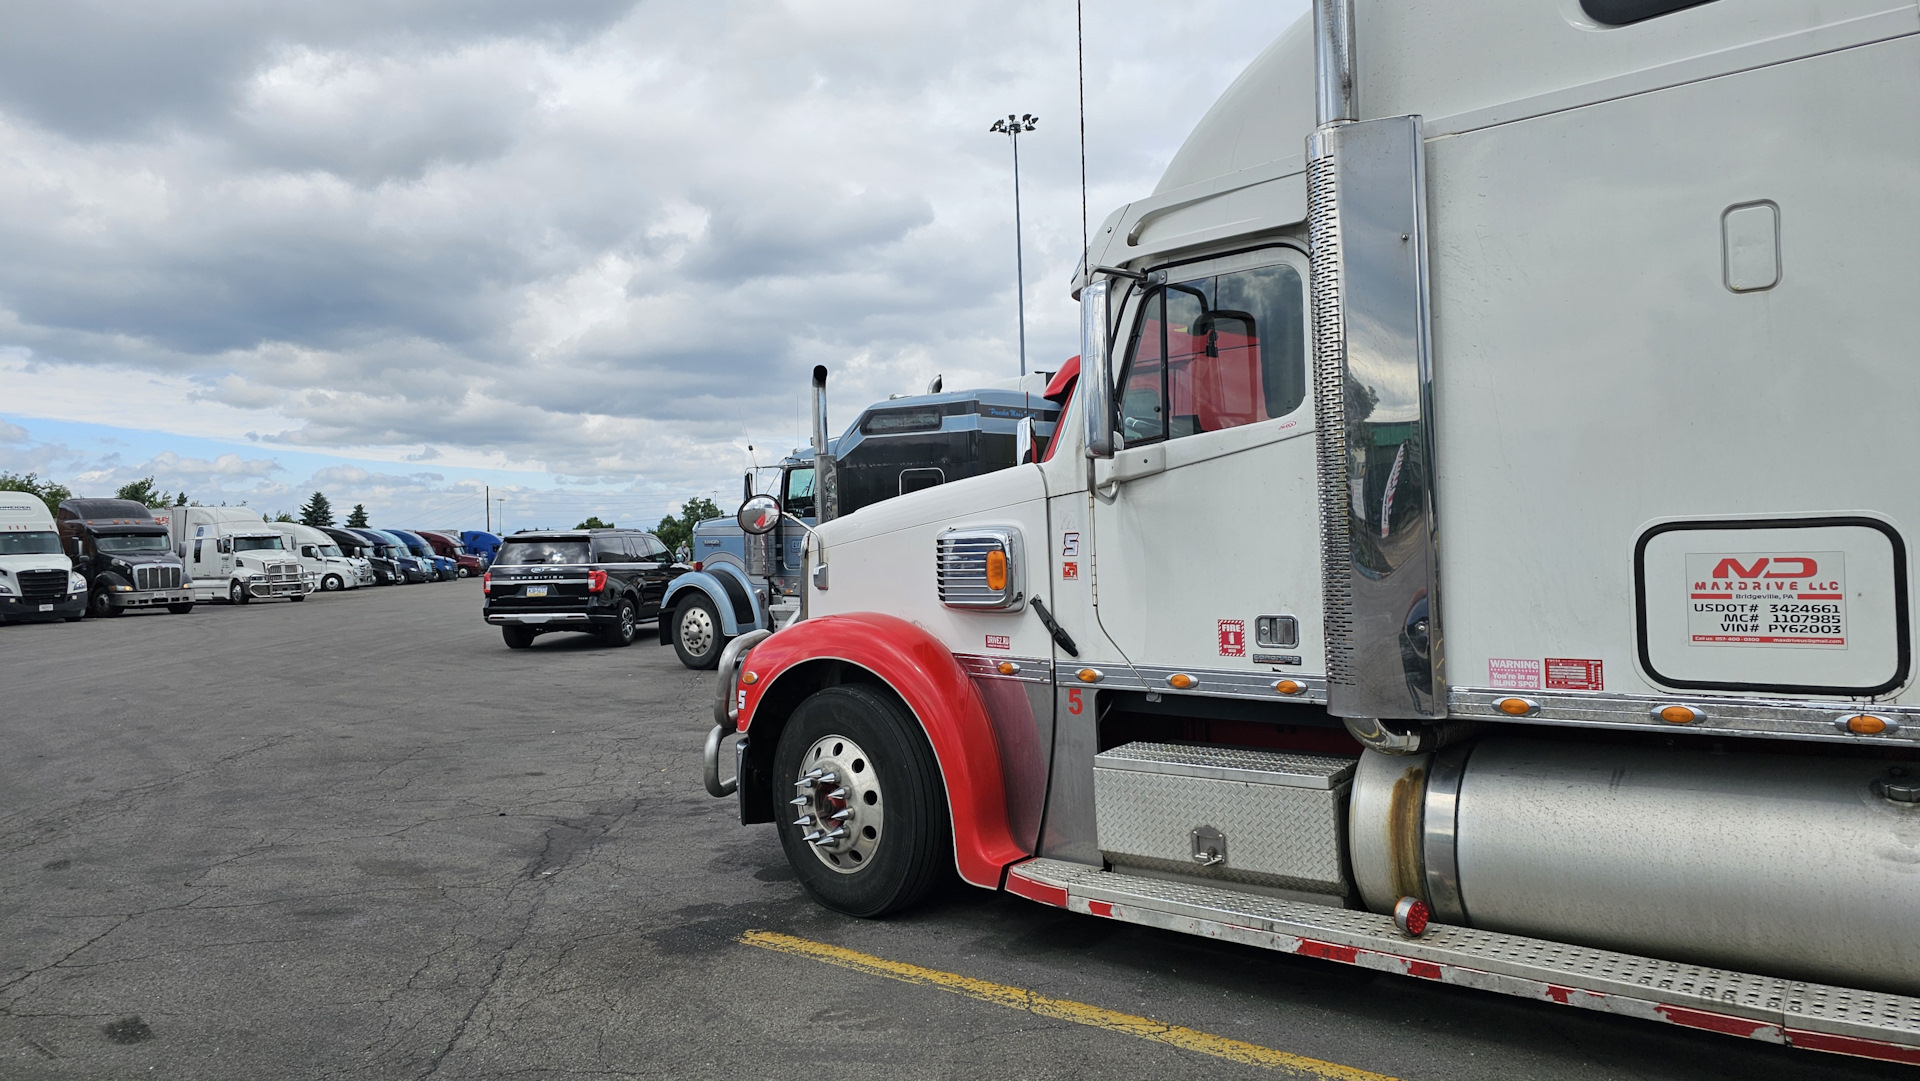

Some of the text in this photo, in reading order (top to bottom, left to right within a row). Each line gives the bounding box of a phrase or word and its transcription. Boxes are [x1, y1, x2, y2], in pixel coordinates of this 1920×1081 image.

[1062, 532, 1080, 556] 5
[1694, 581, 1839, 591] MAXDRIVE LLC
[1694, 603, 1840, 613] USDOT# 3424661
[1724, 614, 1841, 624] MC# 1107985
[1222, 624, 1241, 632] FIRE
[1721, 623, 1841, 634] VIN# PY62003
[1490, 660, 1539, 669] WARNING
[738, 690, 747, 710] 5
[1068, 689, 1083, 715] 5
